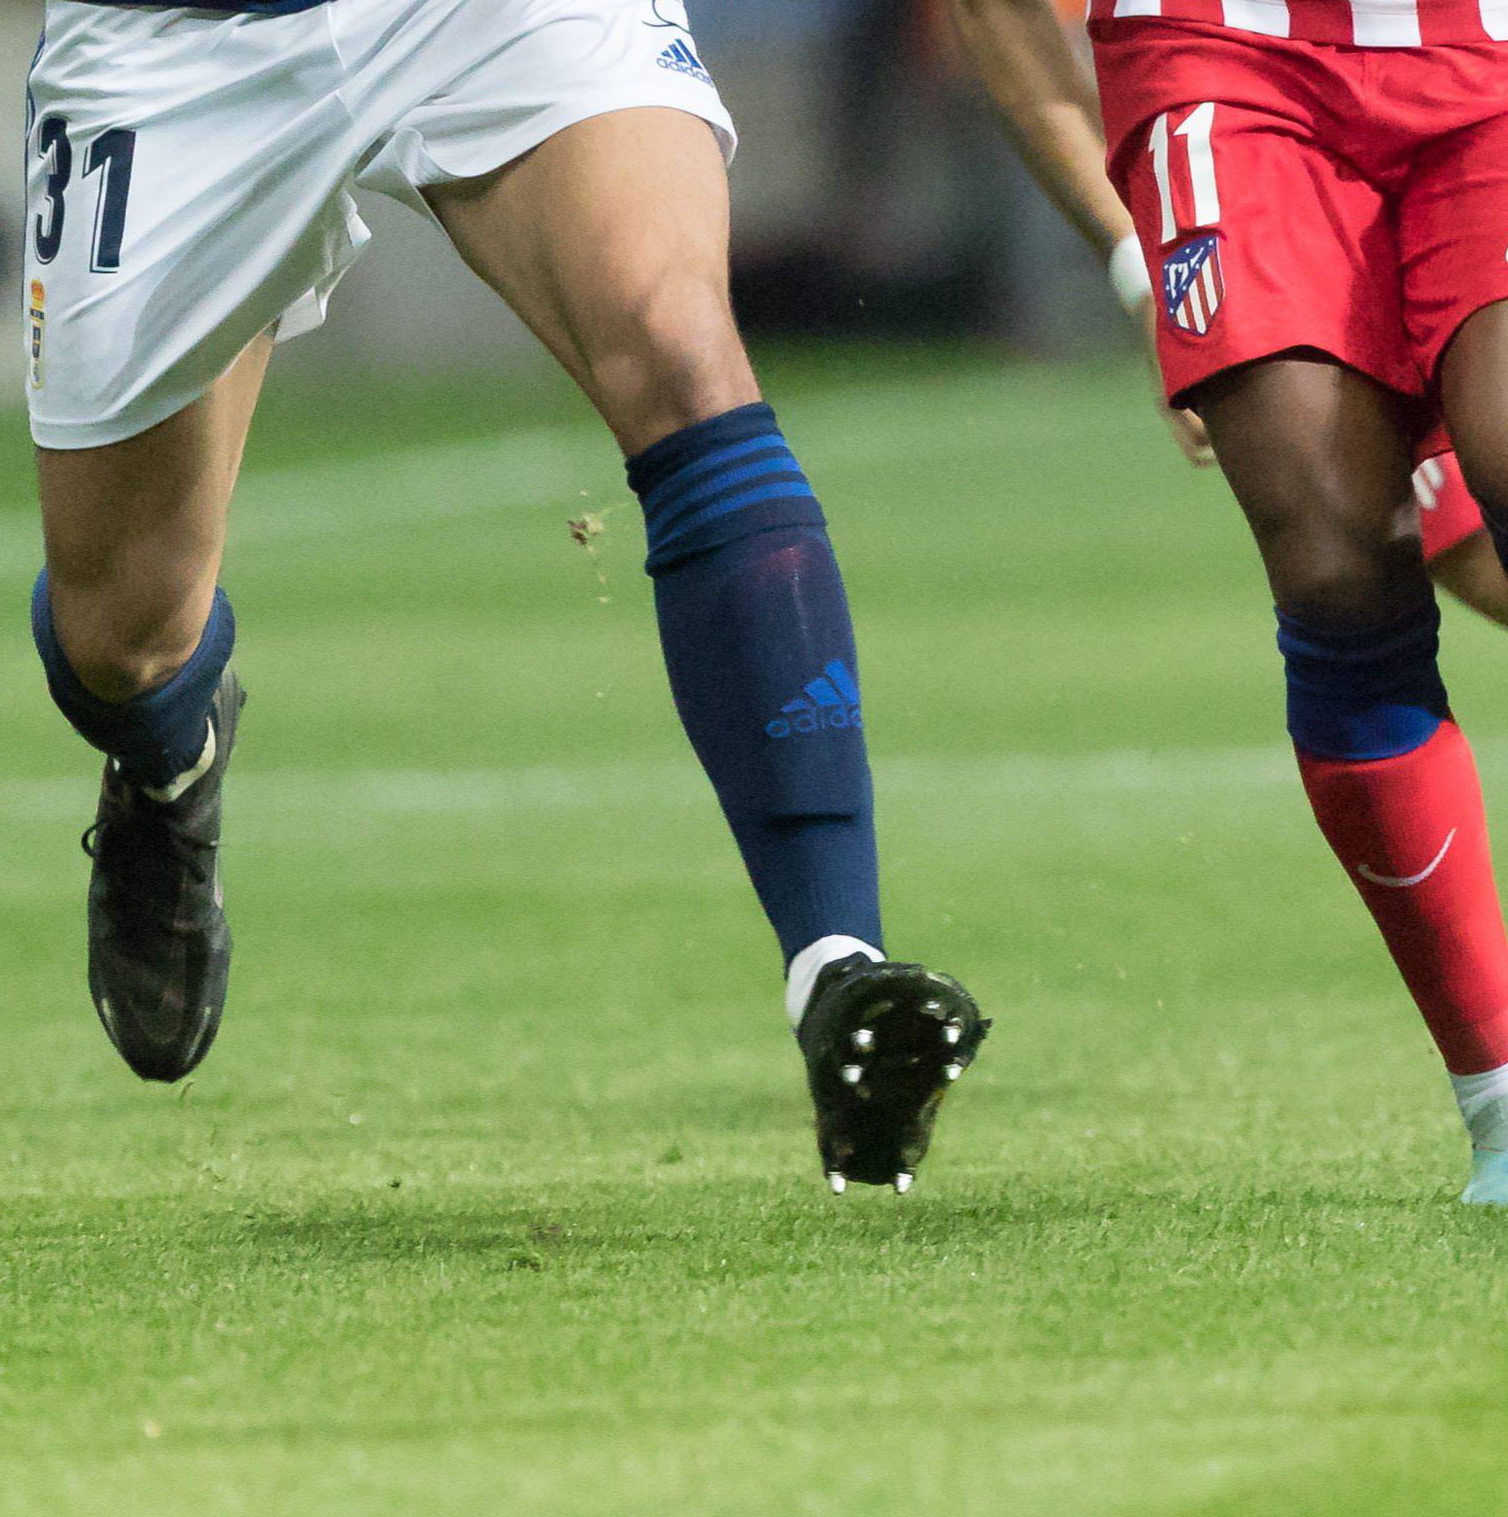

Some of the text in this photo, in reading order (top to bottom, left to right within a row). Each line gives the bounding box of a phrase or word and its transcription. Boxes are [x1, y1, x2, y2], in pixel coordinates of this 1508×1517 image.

[655, 56, 715, 89] adidas
[35, 117, 137, 273] 31
[1148, 101, 1221, 245] 11
